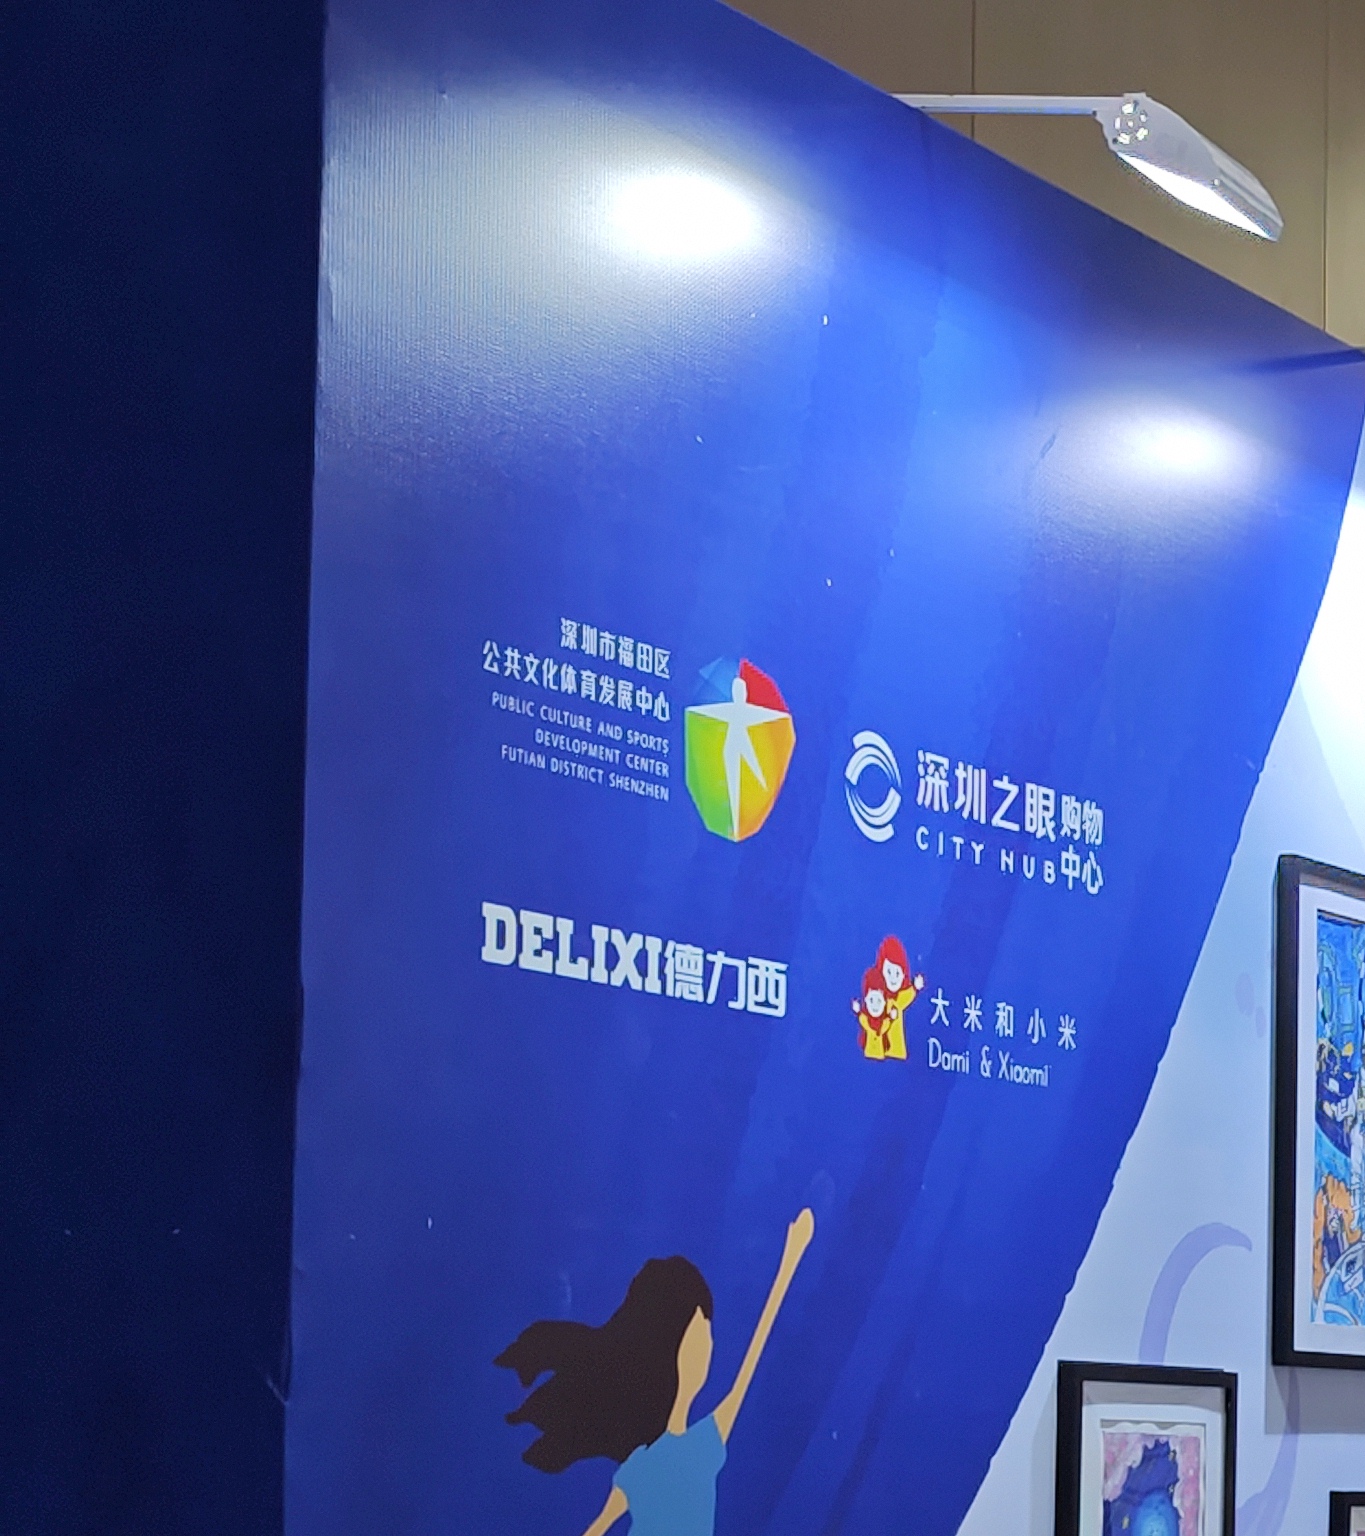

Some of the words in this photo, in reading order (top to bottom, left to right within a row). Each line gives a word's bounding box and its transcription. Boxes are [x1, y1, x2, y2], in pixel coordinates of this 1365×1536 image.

[560, 617, 671, 680] 深圳市福田区
[483, 640, 671, 722] 公共文化体育发展中心
[492, 691, 535, 717] PUBLIC
[540, 705, 592, 733] CULTURE
[597, 721, 623, 740] AND
[627, 729, 670, 754] SPORTS
[535, 728, 621, 765] DEVELOPMENT
[625, 753, 670, 778] CENTER
[501, 744, 546, 769] FUTIAN
[551, 757, 604, 784] DISTRICT
[609, 772, 670, 802] SHENZHEN
[916, 749, 1057, 843] 深圳之眼
[1060, 794, 1104, 846] 购物
[916, 826, 985, 865] CITY
[1001, 848, 1057, 885] HUB
[1060, 844, 1104, 895] 中心
[481, 901, 789, 1018] DELIXI德力西
[930, 987, 1077, 1050] 大米和小米
[928, 1037, 969, 1074] Dami
[980, 1045, 992, 1079] &
[998, 1050, 1049, 1087] Xiaomi
